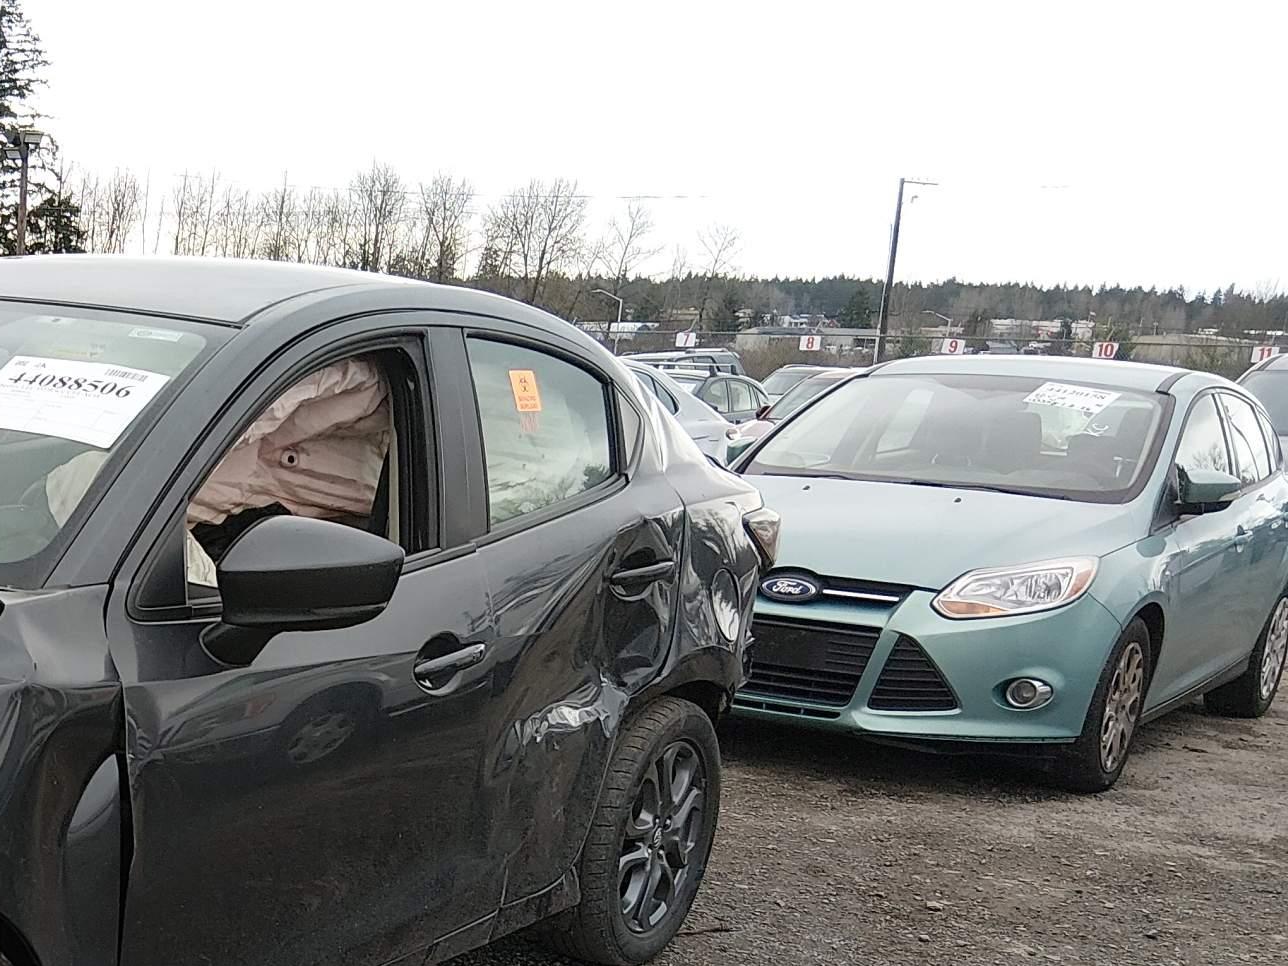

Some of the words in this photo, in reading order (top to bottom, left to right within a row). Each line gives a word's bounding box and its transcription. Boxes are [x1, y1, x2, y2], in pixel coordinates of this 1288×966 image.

[682, 334, 691, 346] 7
[805, 336, 815, 349] 8
[948, 339, 959, 353] 9
[1097, 343, 1114, 358] 10
[1258, 347, 1273, 361] 11
[9, 371, 137, 398] 44088506
[772, 580, 804, 595] Ford
